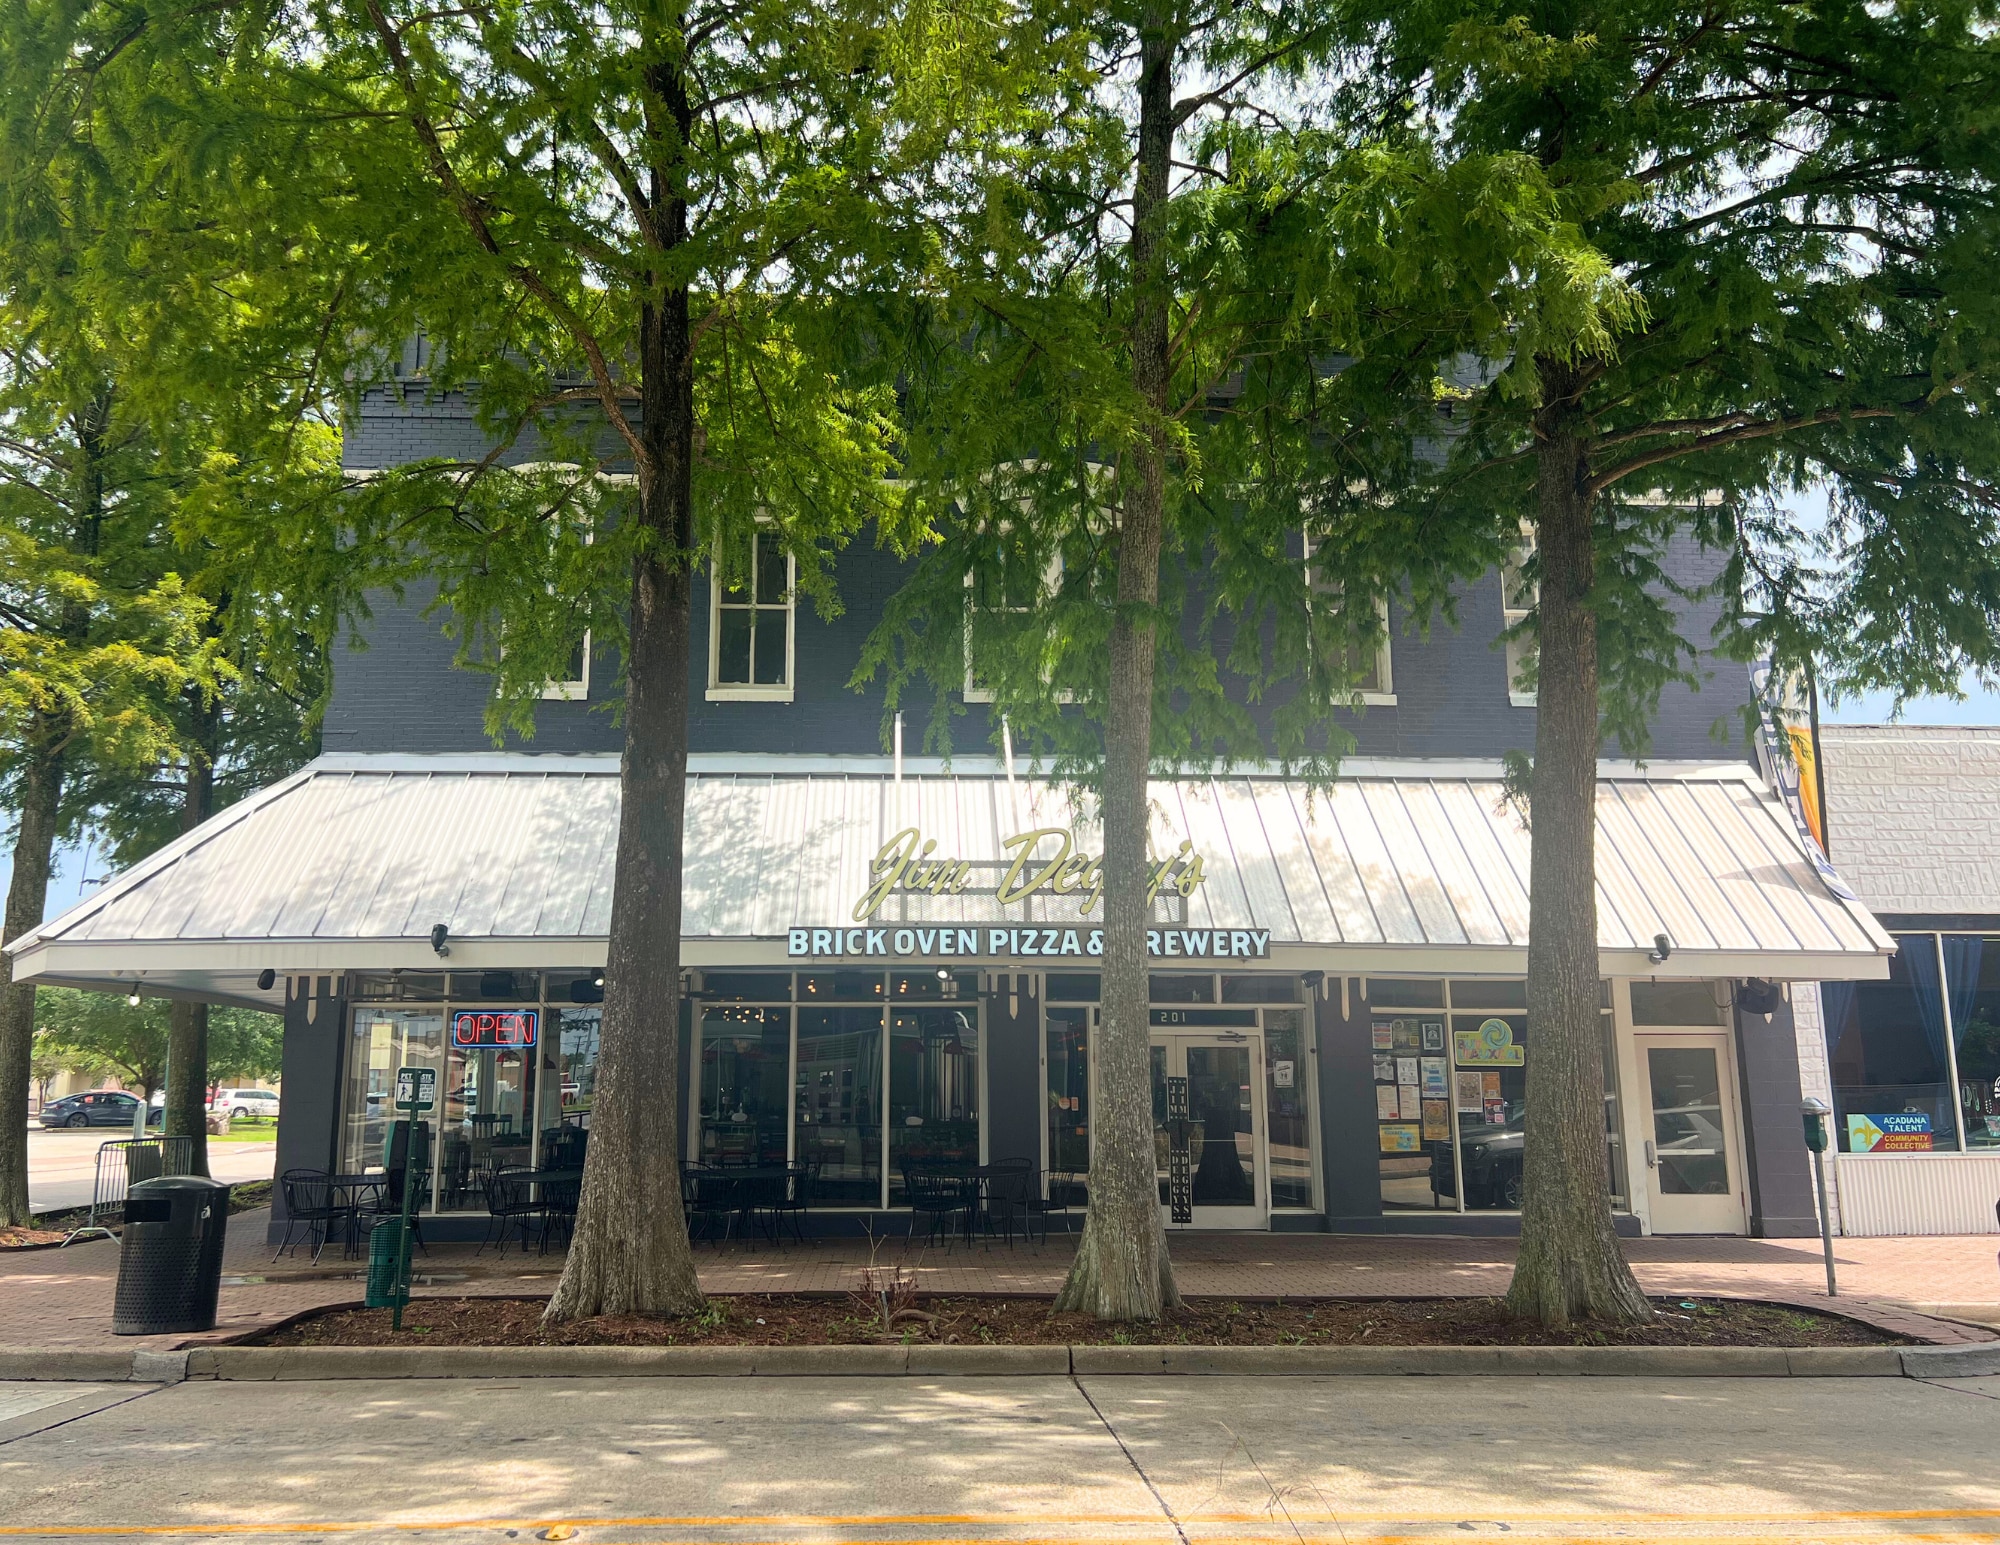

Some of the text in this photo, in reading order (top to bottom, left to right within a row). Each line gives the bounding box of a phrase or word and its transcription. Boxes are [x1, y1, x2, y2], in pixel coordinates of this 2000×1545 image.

[851, 827, 1206, 922] Jim Degy's
[788, 929, 1270, 957] BRICK OVEN PIZZA & REWERY
[457, 1015, 533, 1043] OPEN
[1160, 1011, 1186, 1023] 201
[1170, 1085, 1180, 1214] JIM DEGGYS
[1179, 1085, 1190, 1214] JIM DEGGYS
